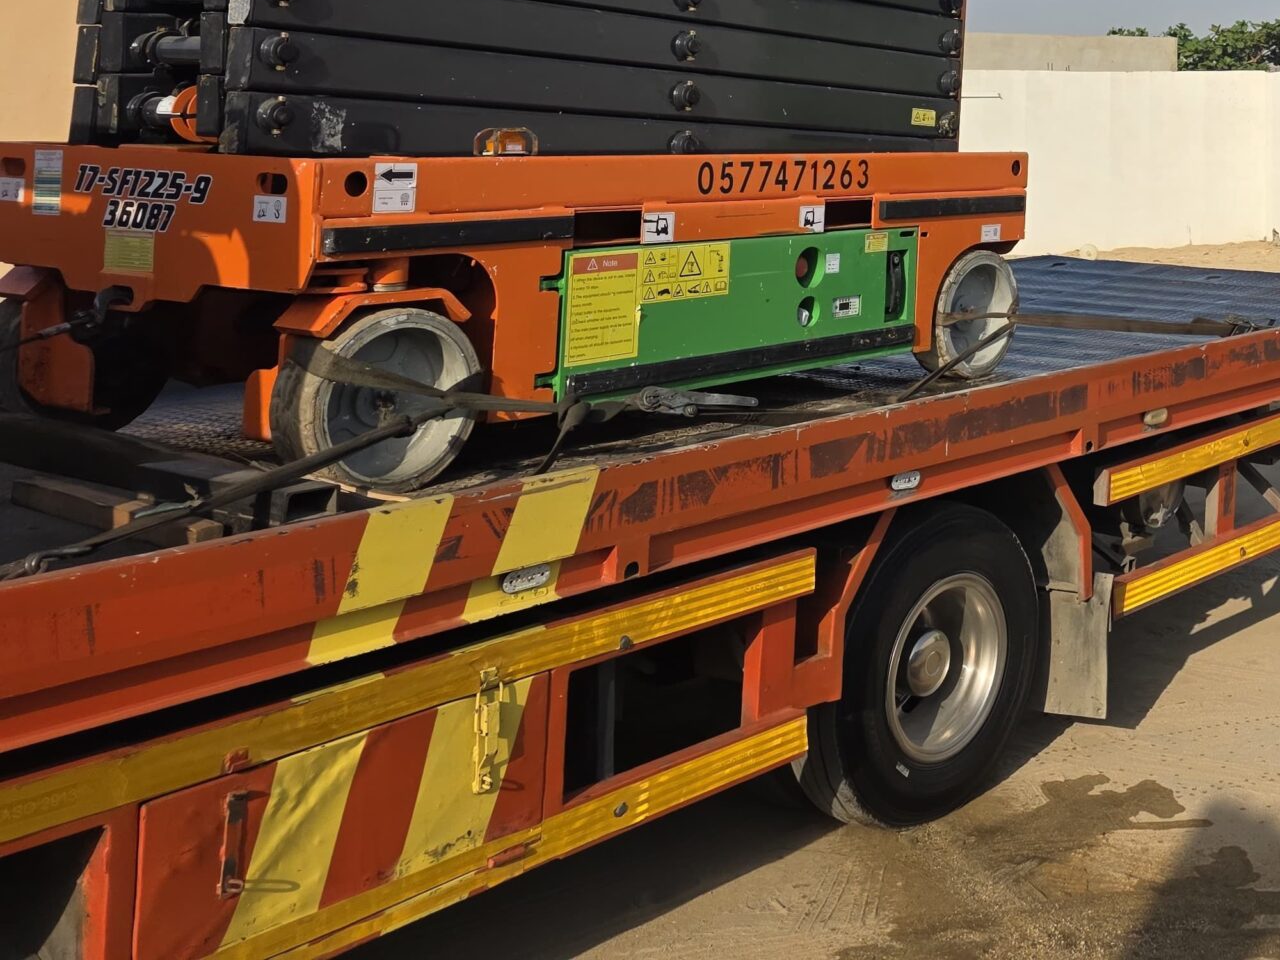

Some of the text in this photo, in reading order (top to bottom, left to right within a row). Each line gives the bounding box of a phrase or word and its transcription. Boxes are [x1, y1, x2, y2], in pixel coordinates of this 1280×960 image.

[75, 165, 212, 203] 17-SF1225-9
[697, 159, 869, 195] 0577471263
[103, 199, 175, 231] 36087
[603, 259, 618, 267] Note
